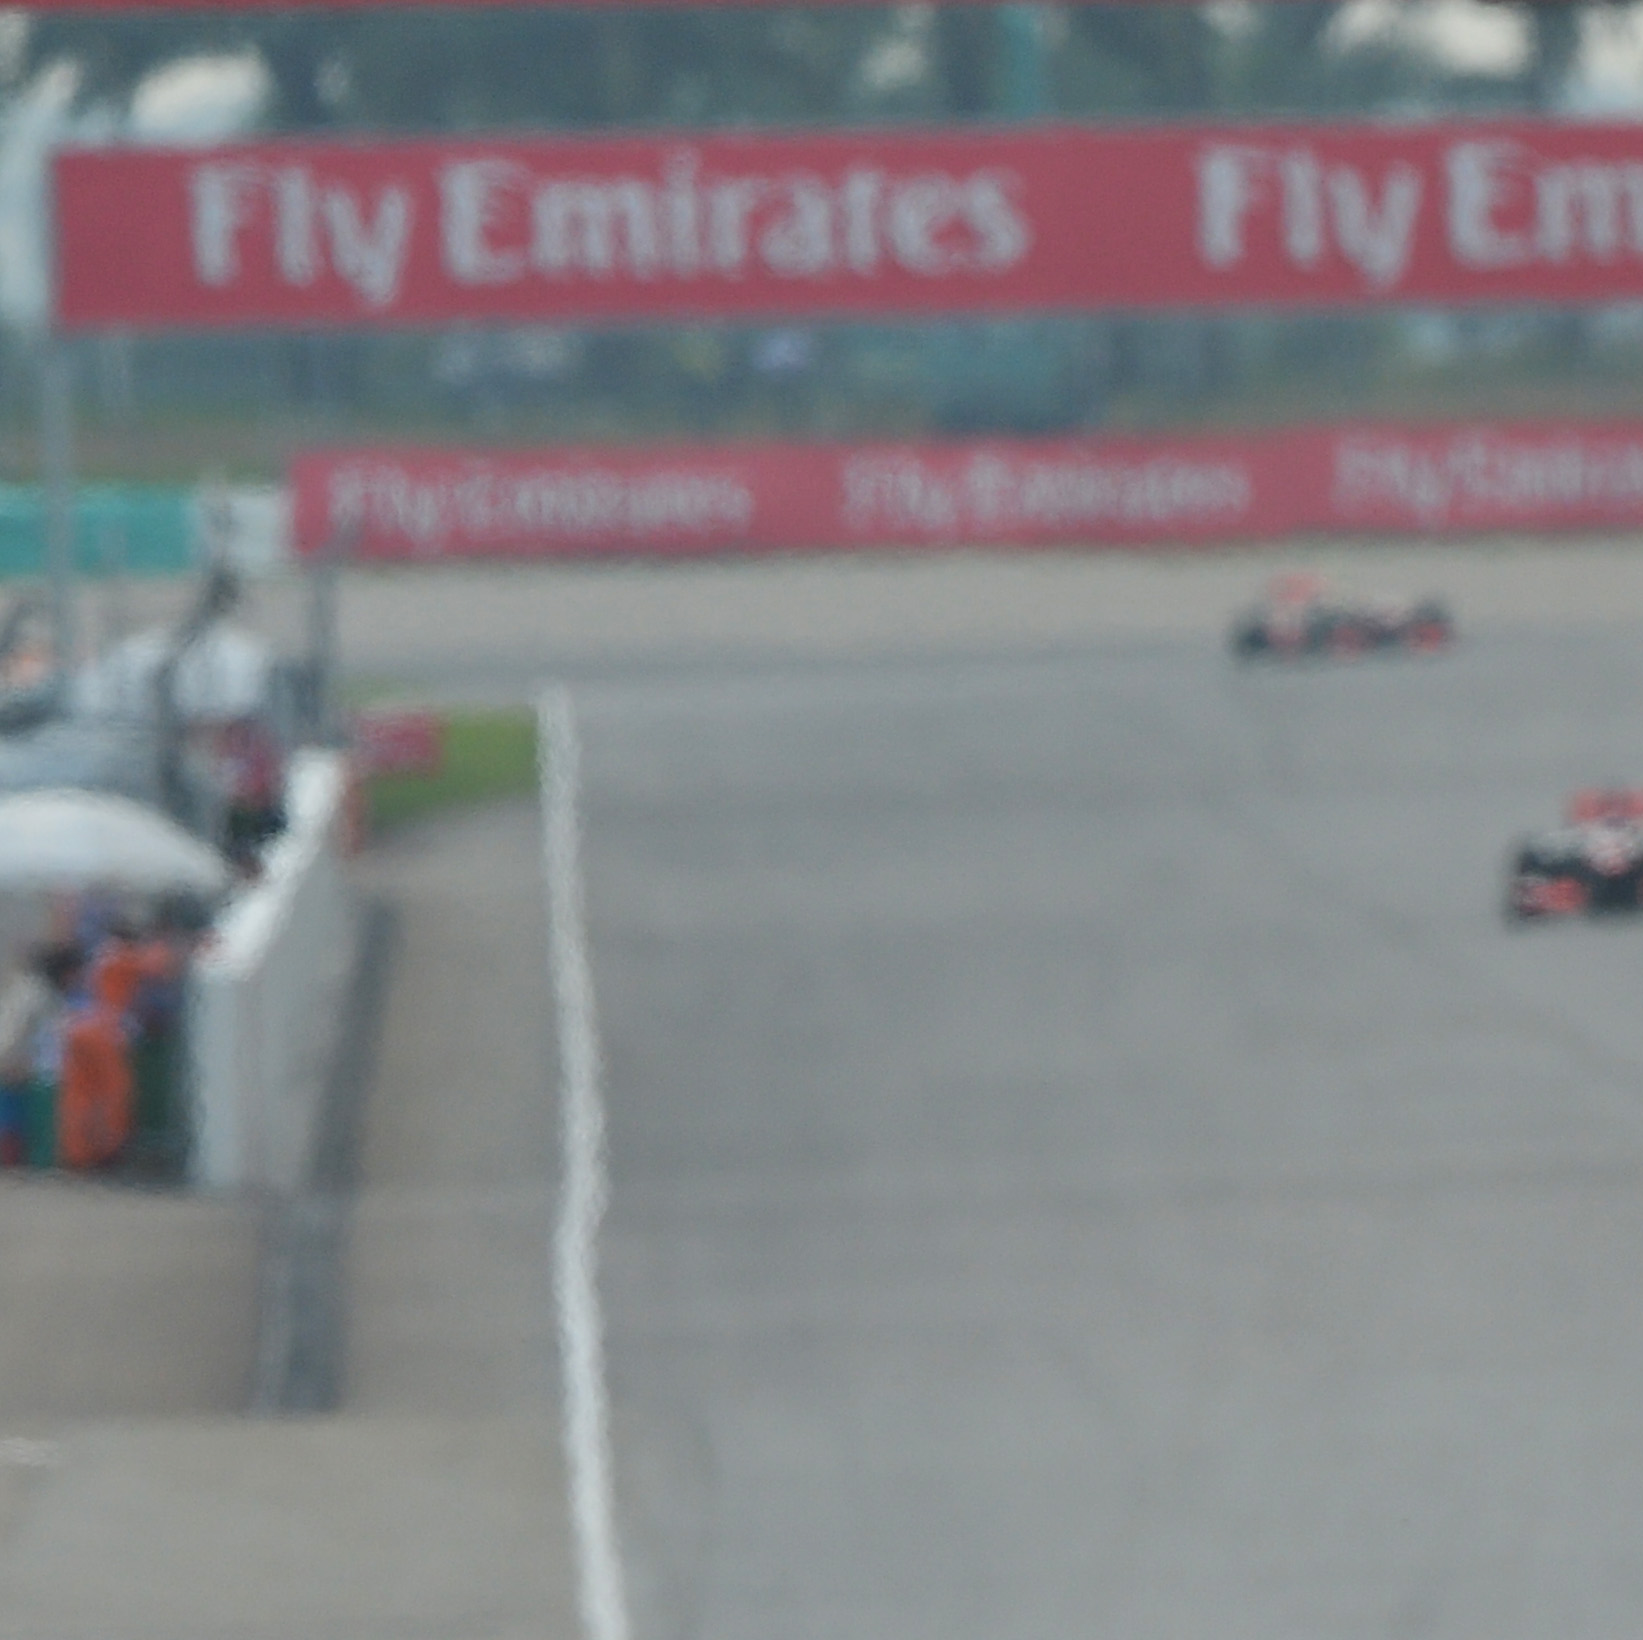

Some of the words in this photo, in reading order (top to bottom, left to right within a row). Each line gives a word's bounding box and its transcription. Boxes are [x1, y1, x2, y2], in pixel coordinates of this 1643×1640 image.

[185, 157, 411, 309] Fly
[438, 145, 1031, 286] Emirates
[1196, 142, 1422, 289] Fly
